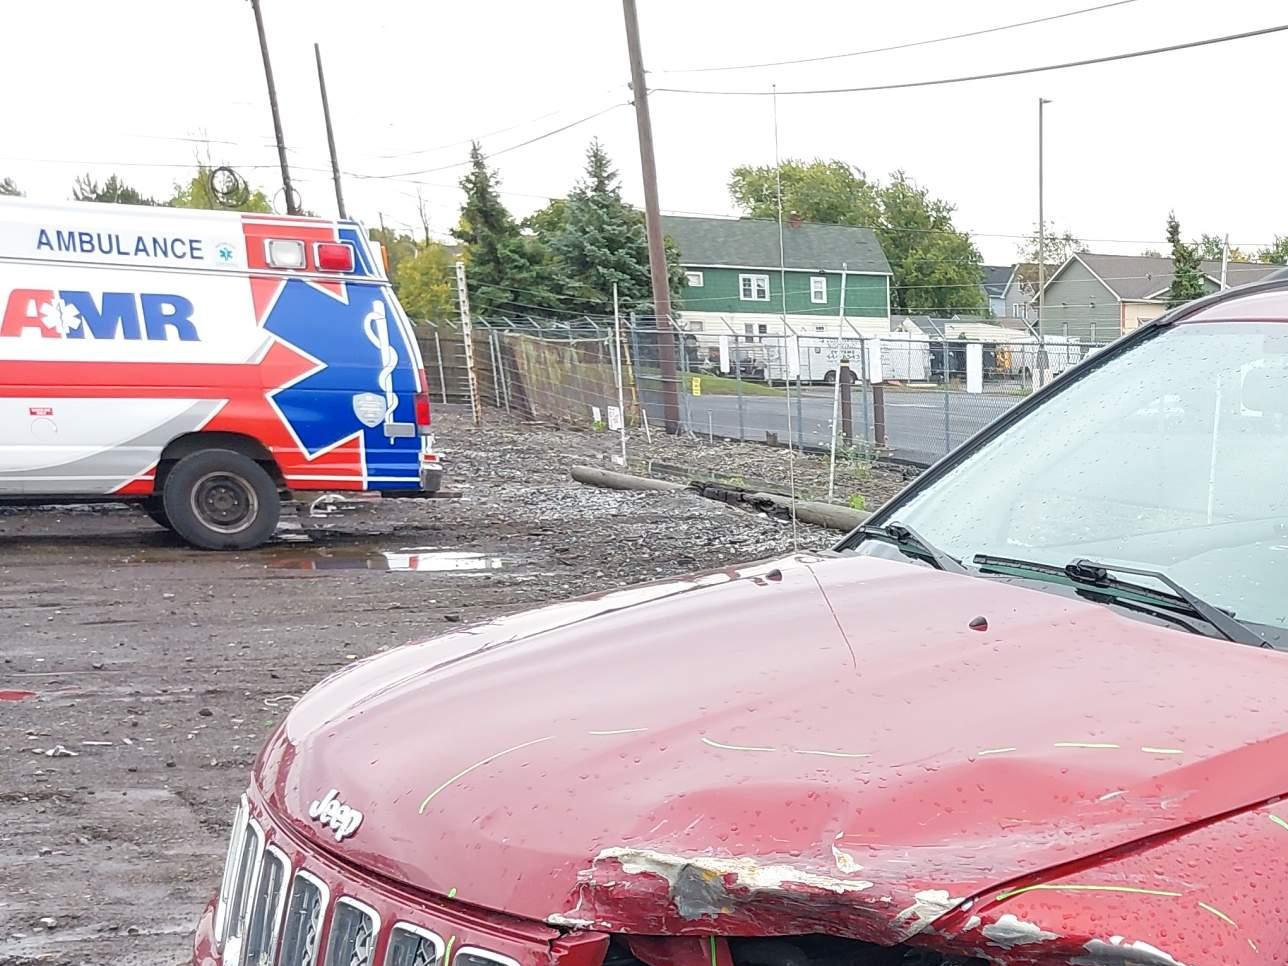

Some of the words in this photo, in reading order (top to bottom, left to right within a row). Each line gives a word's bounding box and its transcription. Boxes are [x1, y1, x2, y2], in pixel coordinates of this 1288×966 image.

[36, 228, 205, 260] AMBULANCE
[0, 288, 201, 342] AMR
[309, 788, 364, 842] Jeep
